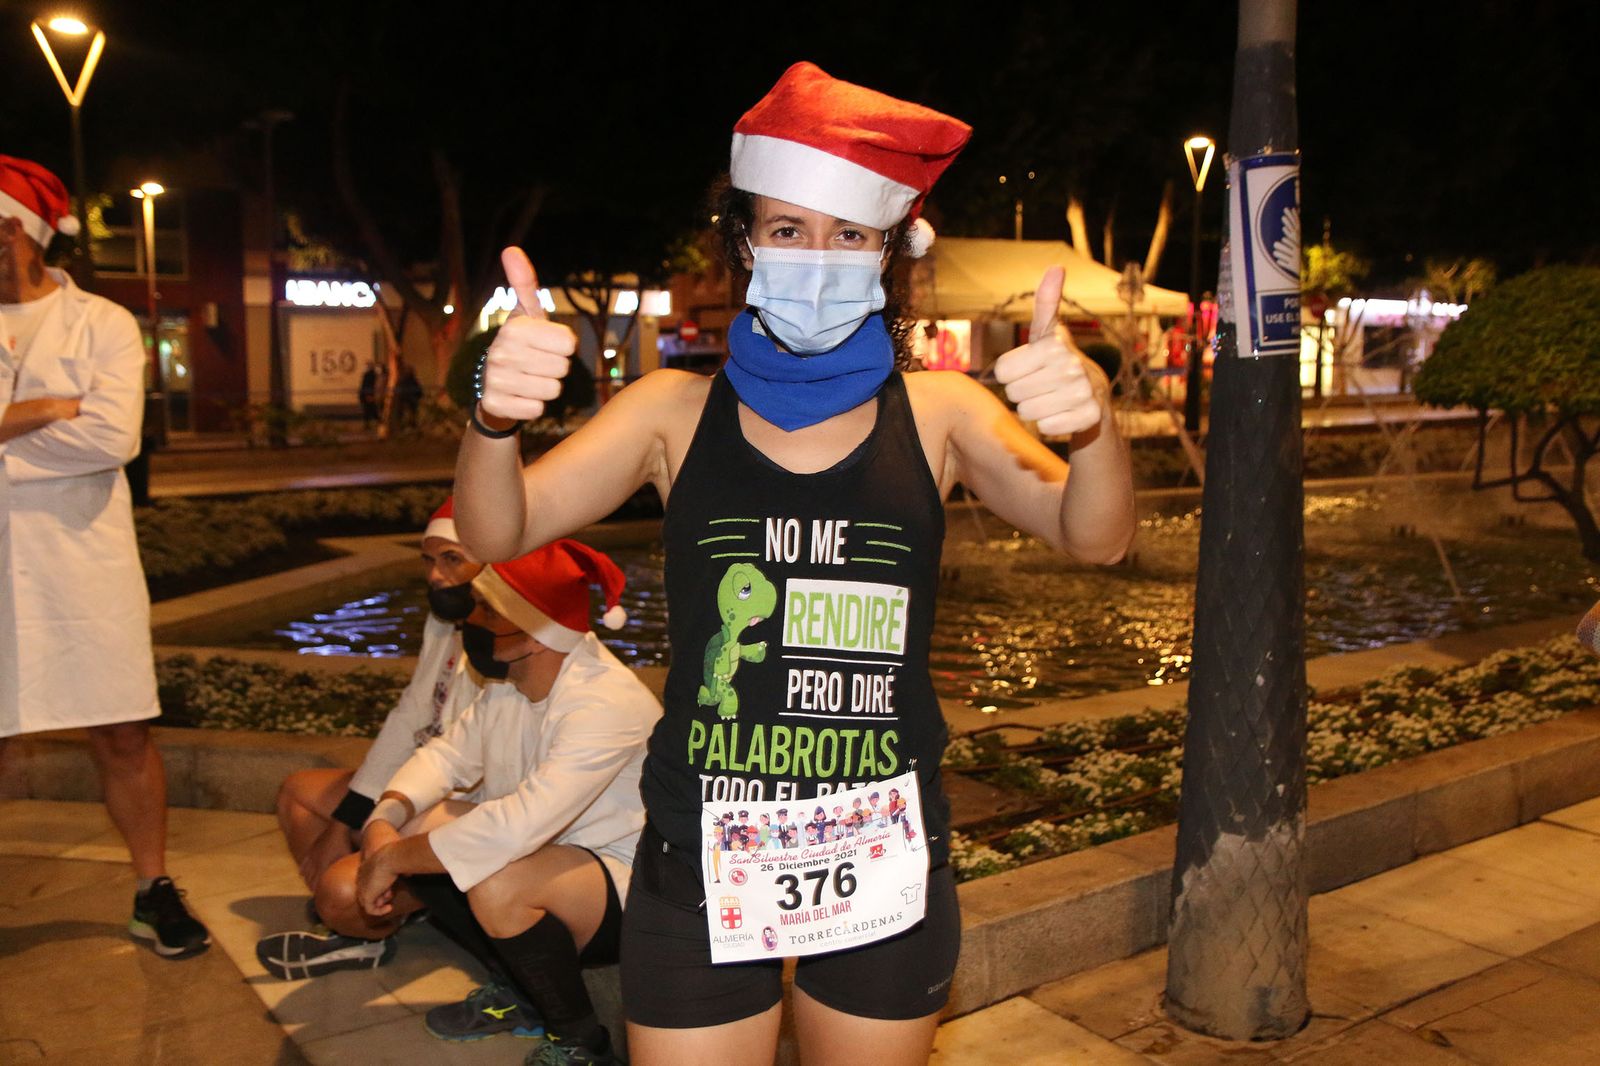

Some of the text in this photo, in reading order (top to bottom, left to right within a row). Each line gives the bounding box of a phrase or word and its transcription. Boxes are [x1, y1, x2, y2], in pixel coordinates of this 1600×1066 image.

[1266, 313, 1285, 324] USE
[310, 350, 357, 375] 150
[766, 517, 848, 565] NO ME
[786, 589, 904, 651] RENDIRÉ
[787, 667, 895, 714] PERO DIRÉ
[688, 719, 899, 778] PALABROTAS
[699, 774, 764, 802] TODO
[760, 849, 857, 872] 26 Diciembre 2021
[801, 842, 838, 859] Ciudad
[840, 840, 852, 852] de
[775, 861, 857, 910] 376
[780, 900, 852, 925] MARÍA DEL MAR
[713, 932, 754, 943] ALMERÍA
